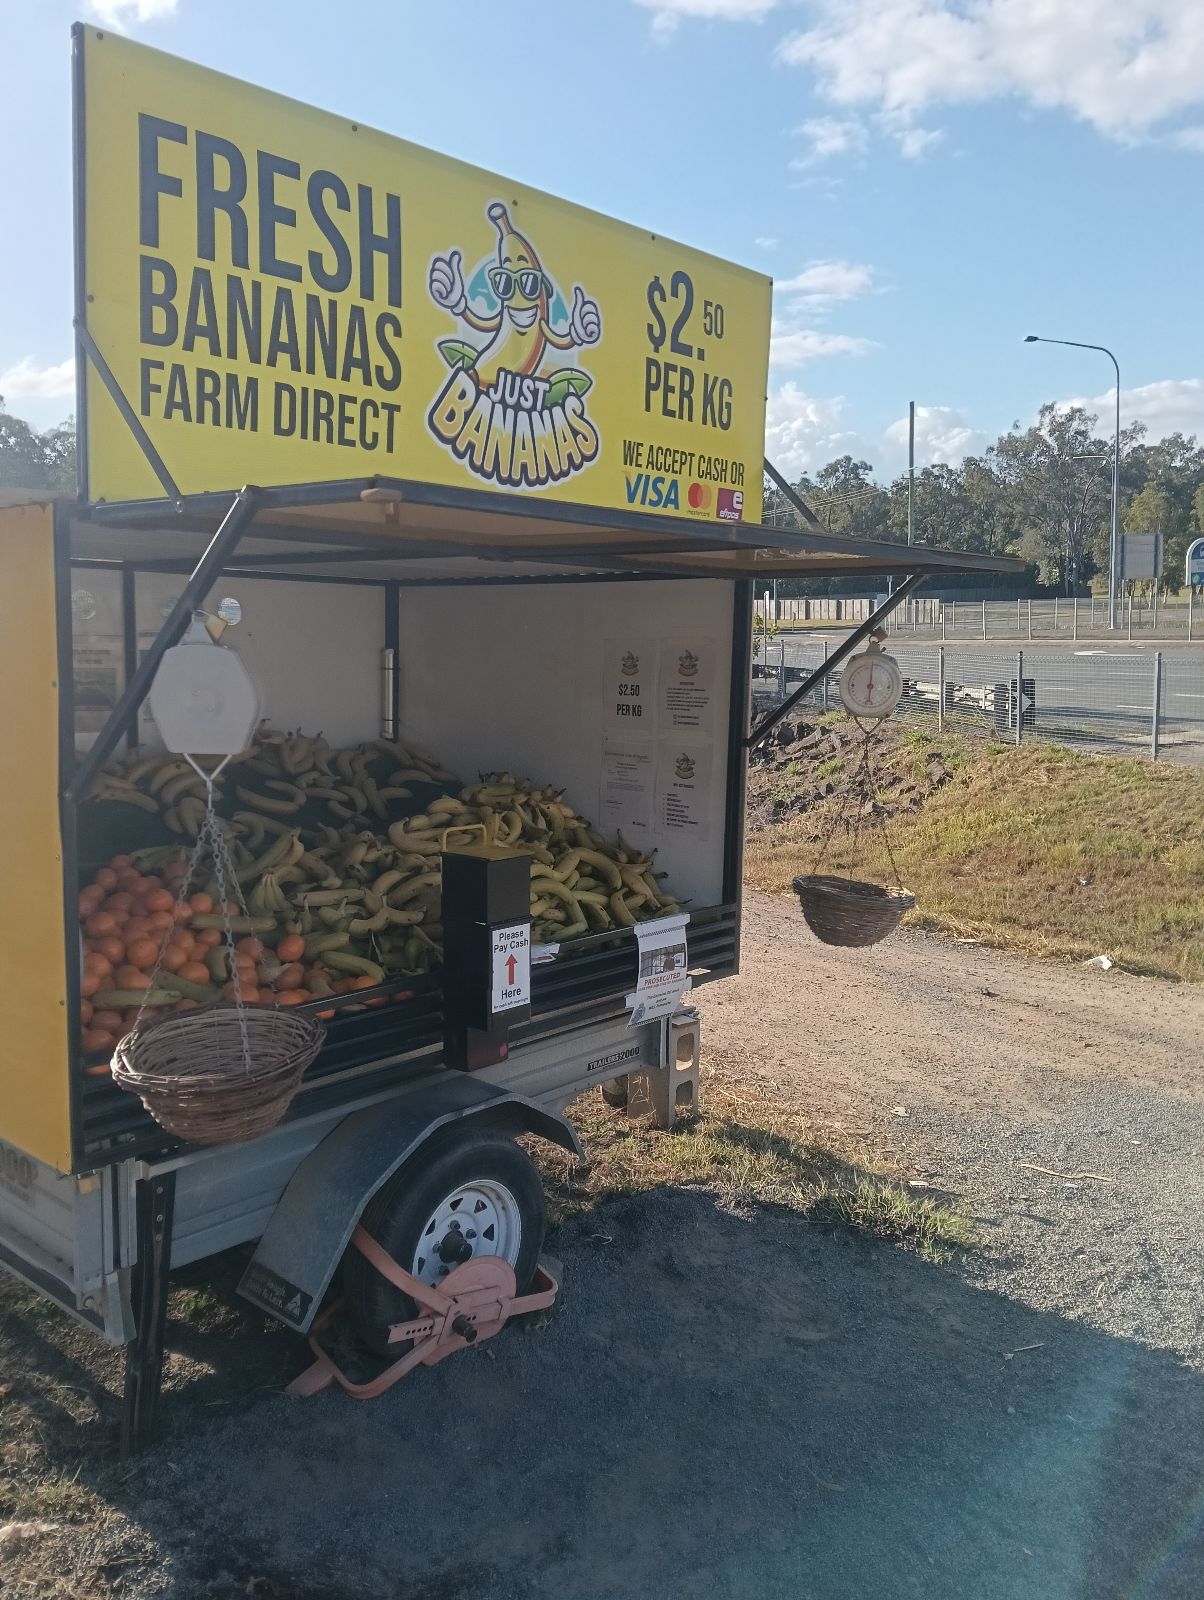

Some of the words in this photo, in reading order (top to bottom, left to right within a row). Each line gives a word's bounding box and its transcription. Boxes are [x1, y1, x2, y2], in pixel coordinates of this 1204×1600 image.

[138, 112, 402, 309] FRESH
[139, 254, 402, 392] BANANAS
[140, 358, 259, 433] FARM
[274, 381, 401, 454] DIRECT
[488, 370, 551, 412] JUST
[644, 357, 695, 422] PER
[702, 373, 732, 431] KG
[431, 369, 597, 482] BANANAS
[623, 440, 644, 468] WE
[645, 445, 696, 477] ACCEPT
[697, 455, 728, 483] CASH
[731, 461, 745, 486] OR
[625, 472, 679, 510] VISA
[618, 683, 640, 696] $2.50
[616, 704, 631, 716] PER
[632, 704, 642, 717] KG
[494, 943, 508, 953] Pay
[509, 938, 529, 950] Cash
[499, 930, 524, 942] Please
[501, 987, 521, 1000] Here
[644, 972, 681, 987] PROSECUTED
